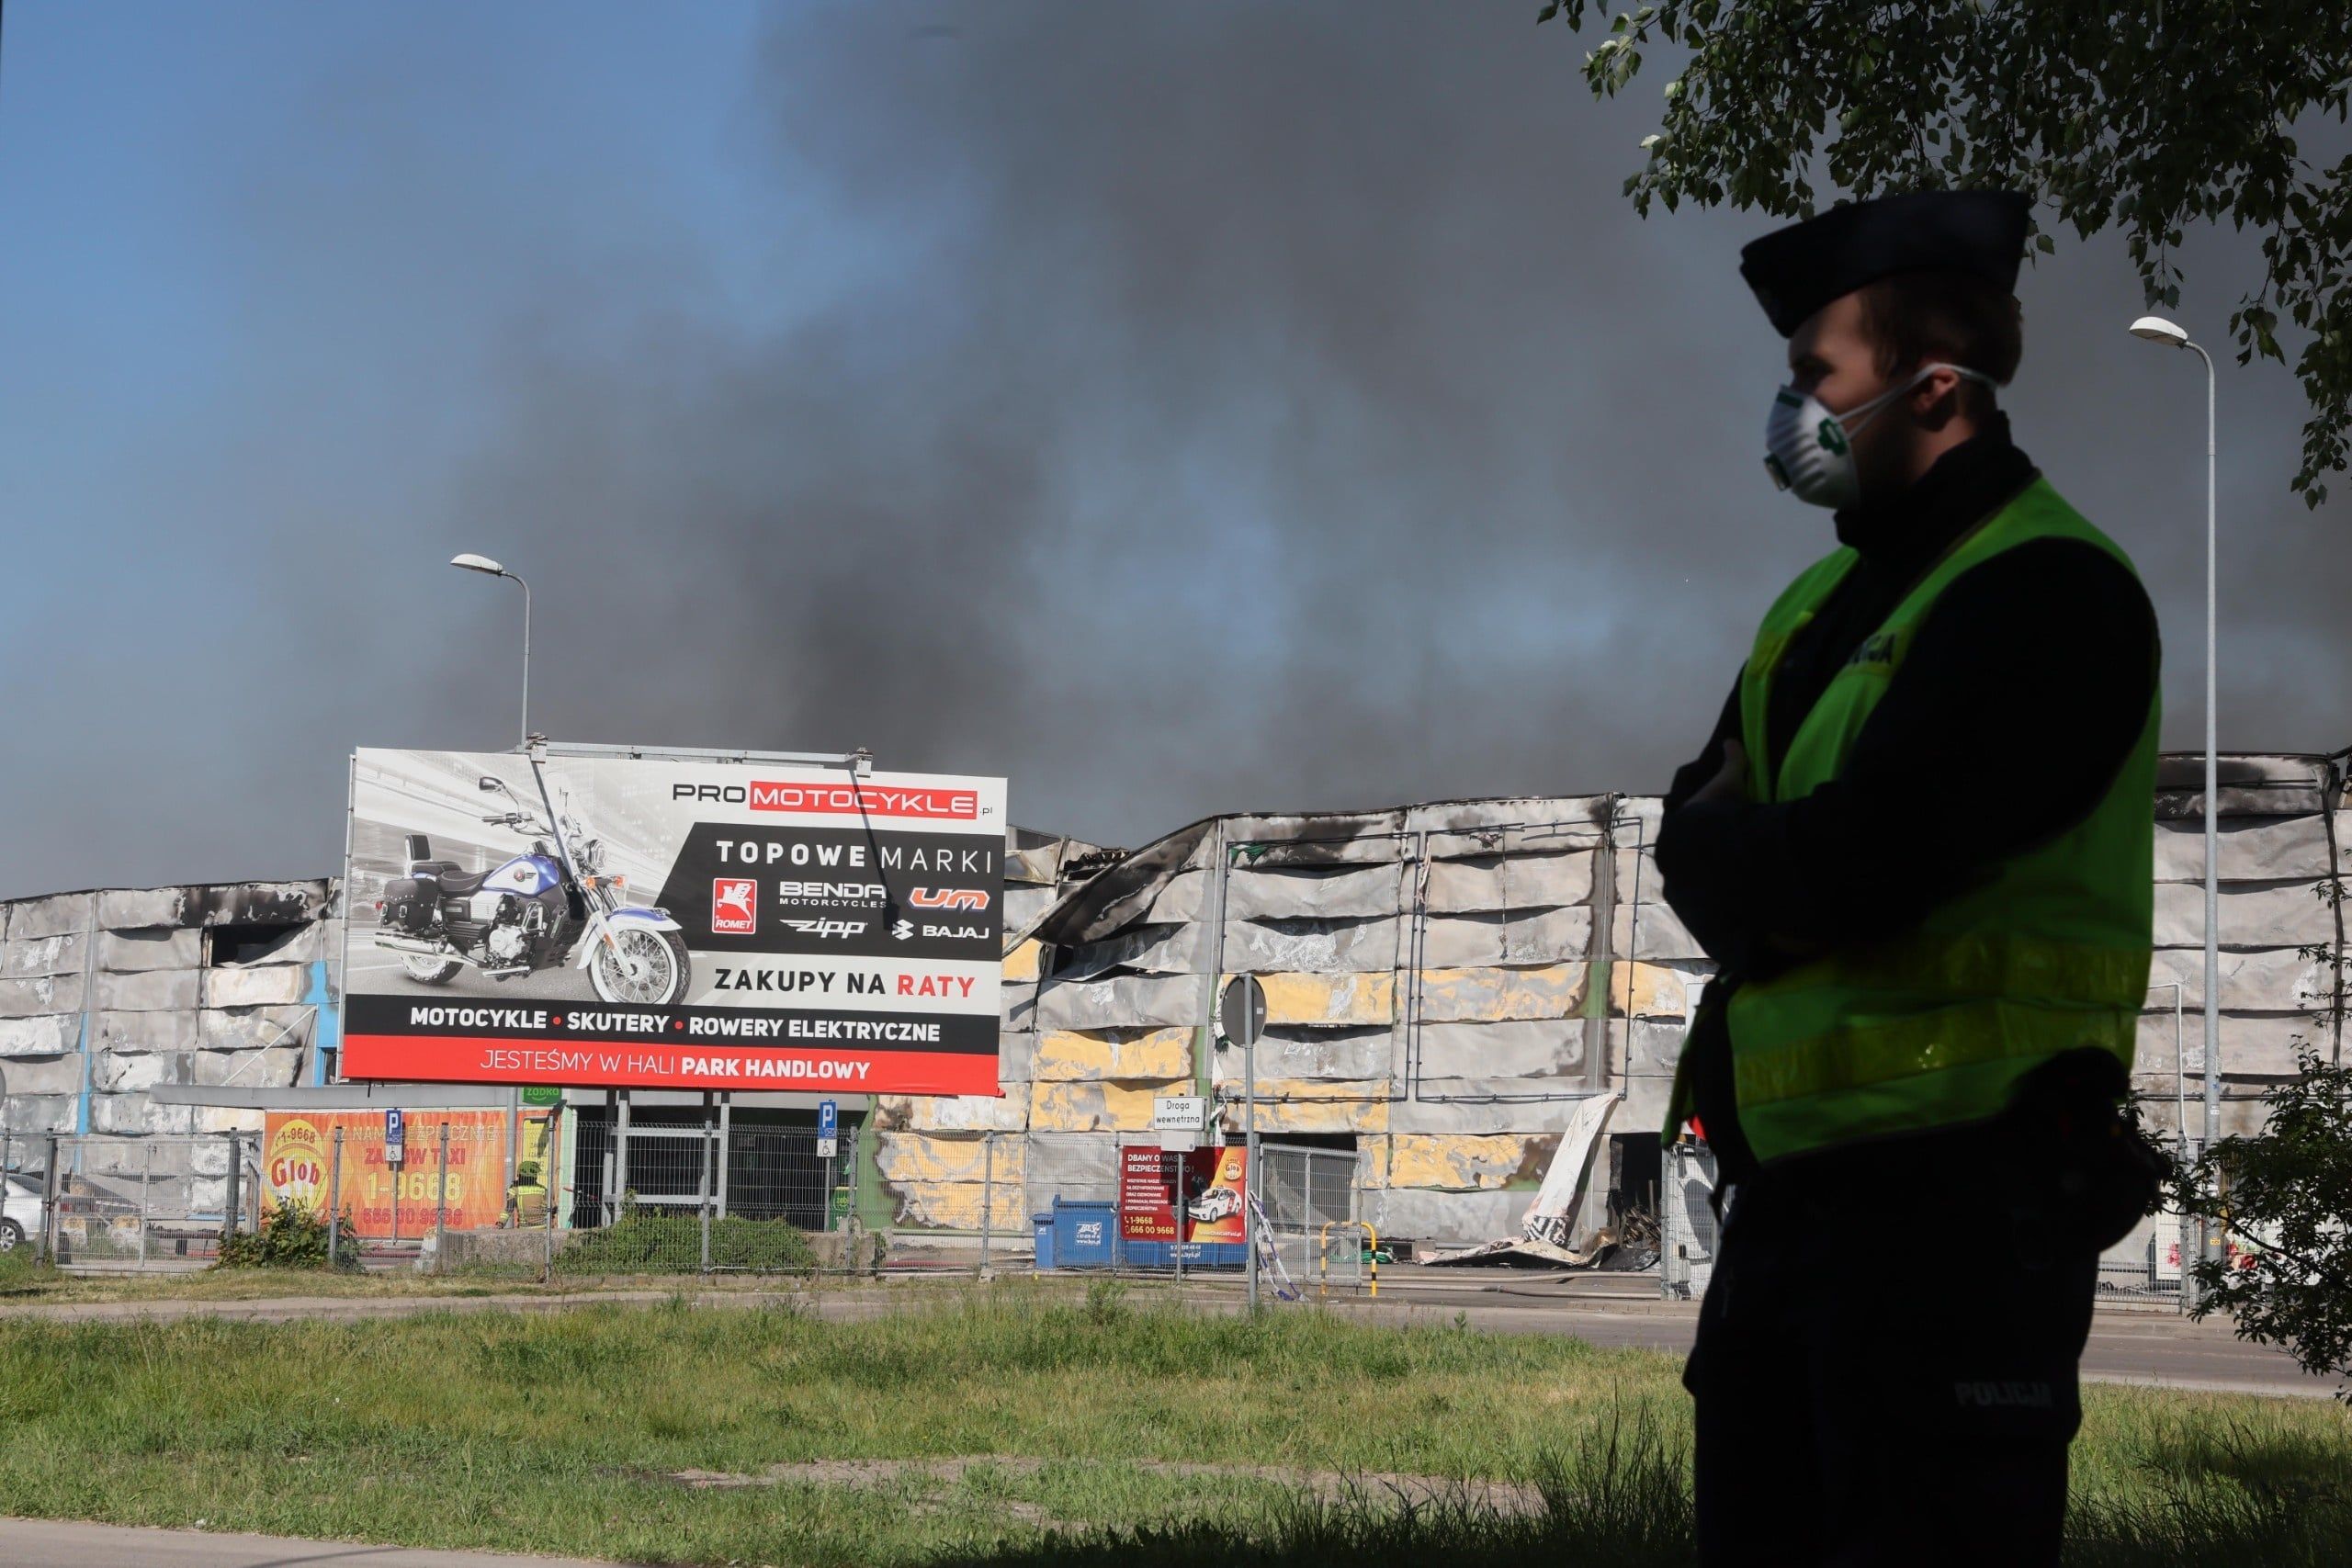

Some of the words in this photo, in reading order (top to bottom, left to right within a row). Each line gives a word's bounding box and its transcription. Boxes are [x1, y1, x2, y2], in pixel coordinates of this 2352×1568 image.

[716, 840, 866, 867] TOPOWE
[880, 846, 991, 874] MARKI
[779, 881, 888, 899] BENDA
[908, 886, 990, 911] UM
[779, 897, 888, 908] MOTORCYCLES
[715, 919, 752, 930] ROMET
[922, 923, 990, 940] BAJAJ
[714, 968, 836, 993] ZAKUPY
[846, 973, 886, 995] NA
[897, 974, 976, 998] RATY
[410, 1007, 548, 1029] MOTOCYKLE
[567, 1011, 670, 1032] SKUTERY
[688, 1016, 784, 1037] ROWERY
[788, 1020, 941, 1042] ELEKTRYCZNE
[480, 1048, 594, 1072] JESTEŚMY
[599, 1054, 622, 1073] W
[628, 1055, 674, 1075] HALI
[681, 1056, 741, 1077] PARK
[745, 1058, 871, 1080] HANDLOWY
[1166, 1100, 1190, 1111] Droga
[388, 1112, 399, 1134] P
[822, 1105, 833, 1128] P
[352, 1126, 386, 1140] NAM
[1127, 1154, 1152, 1162] DBAMY
[1154, 1154, 1160, 1162] O
[1161, 1155, 1187, 1163] WASE
[271, 1157, 320, 1187] Glob
[1127, 1164, 1191, 1173] BEZPIECZEŃSTO
[1130, 1216, 1153, 1224] 1-9668
[1130, 1225, 1144, 1234] 666
[1156, 1226, 1175, 1235] 9668
